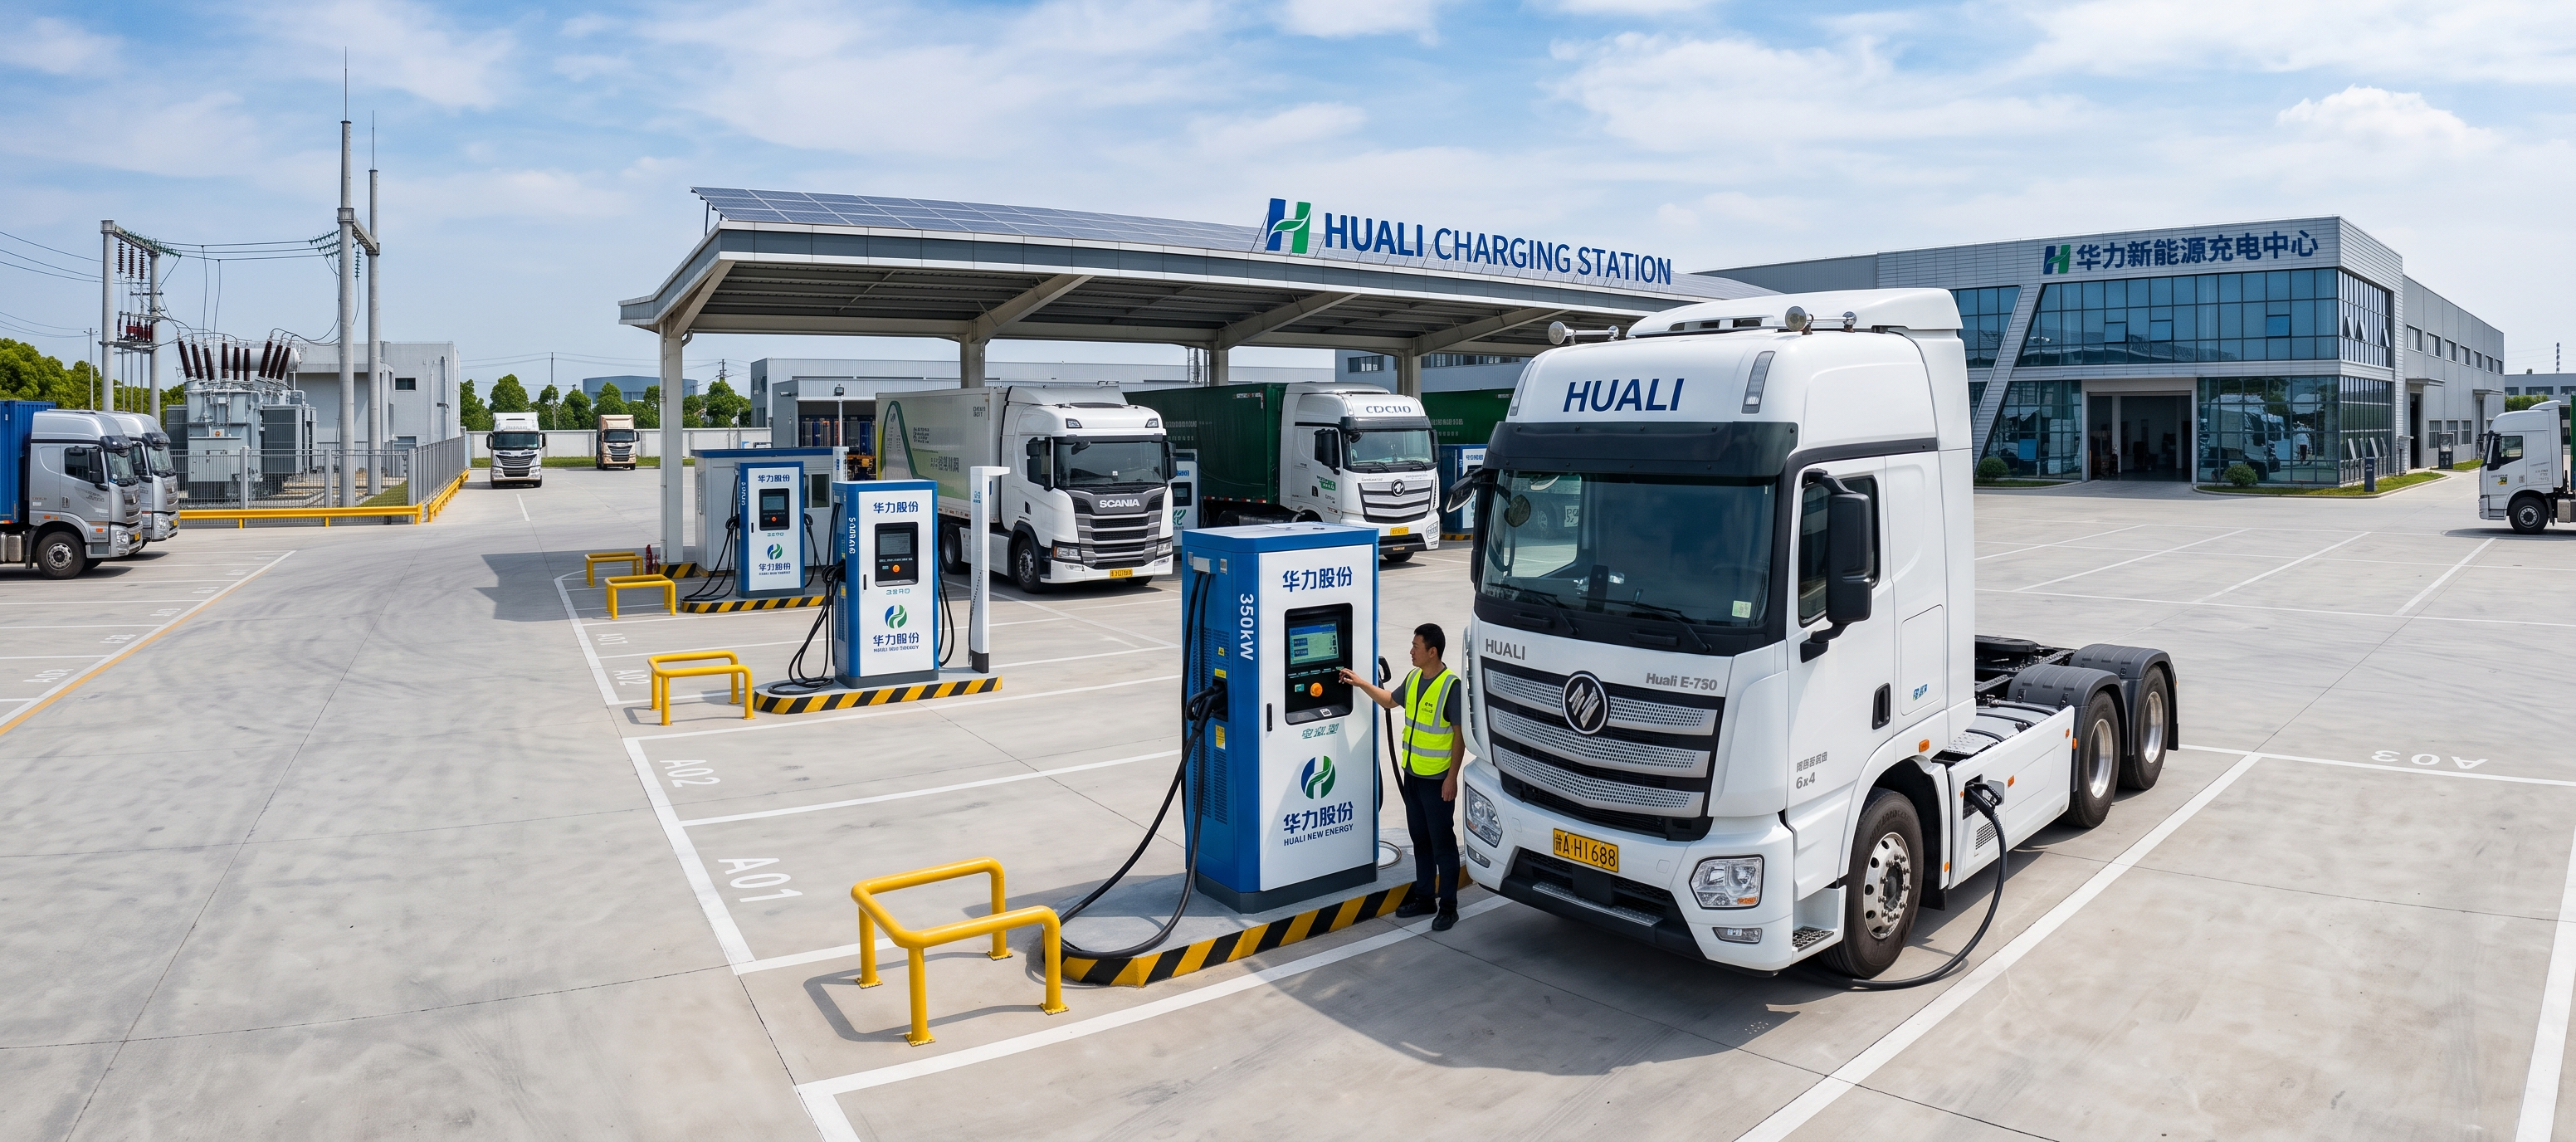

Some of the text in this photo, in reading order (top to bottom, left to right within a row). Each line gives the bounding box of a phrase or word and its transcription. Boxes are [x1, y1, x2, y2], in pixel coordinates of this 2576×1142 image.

[1325, 212, 1423, 257] HUALI
[1434, 227, 1571, 274] CHARGING
[1577, 246, 1671, 286] STATION
[2076, 230, 2319, 271] 华力新能源充电中心
[1563, 378, 1685, 412] HUALI
[1099, 498, 1140, 508] SCANIA
[1282, 566, 1353, 593] 华力股份
[1240, 593, 1254, 661] 350kW
[1486, 638, 1525, 661] HUALI
[612, 669, 651, 686] A02
[1646, 672, 1678, 687] Huali
[2371, 749, 2489, 769] A03
[659, 759, 721, 788] A02
[1795, 772, 1816, 789] 6x4
[1283, 801, 1354, 835] 华力股份
[1284, 823, 1354, 847] HUALI NEW ENERGY
[717, 857, 803, 903] A01
